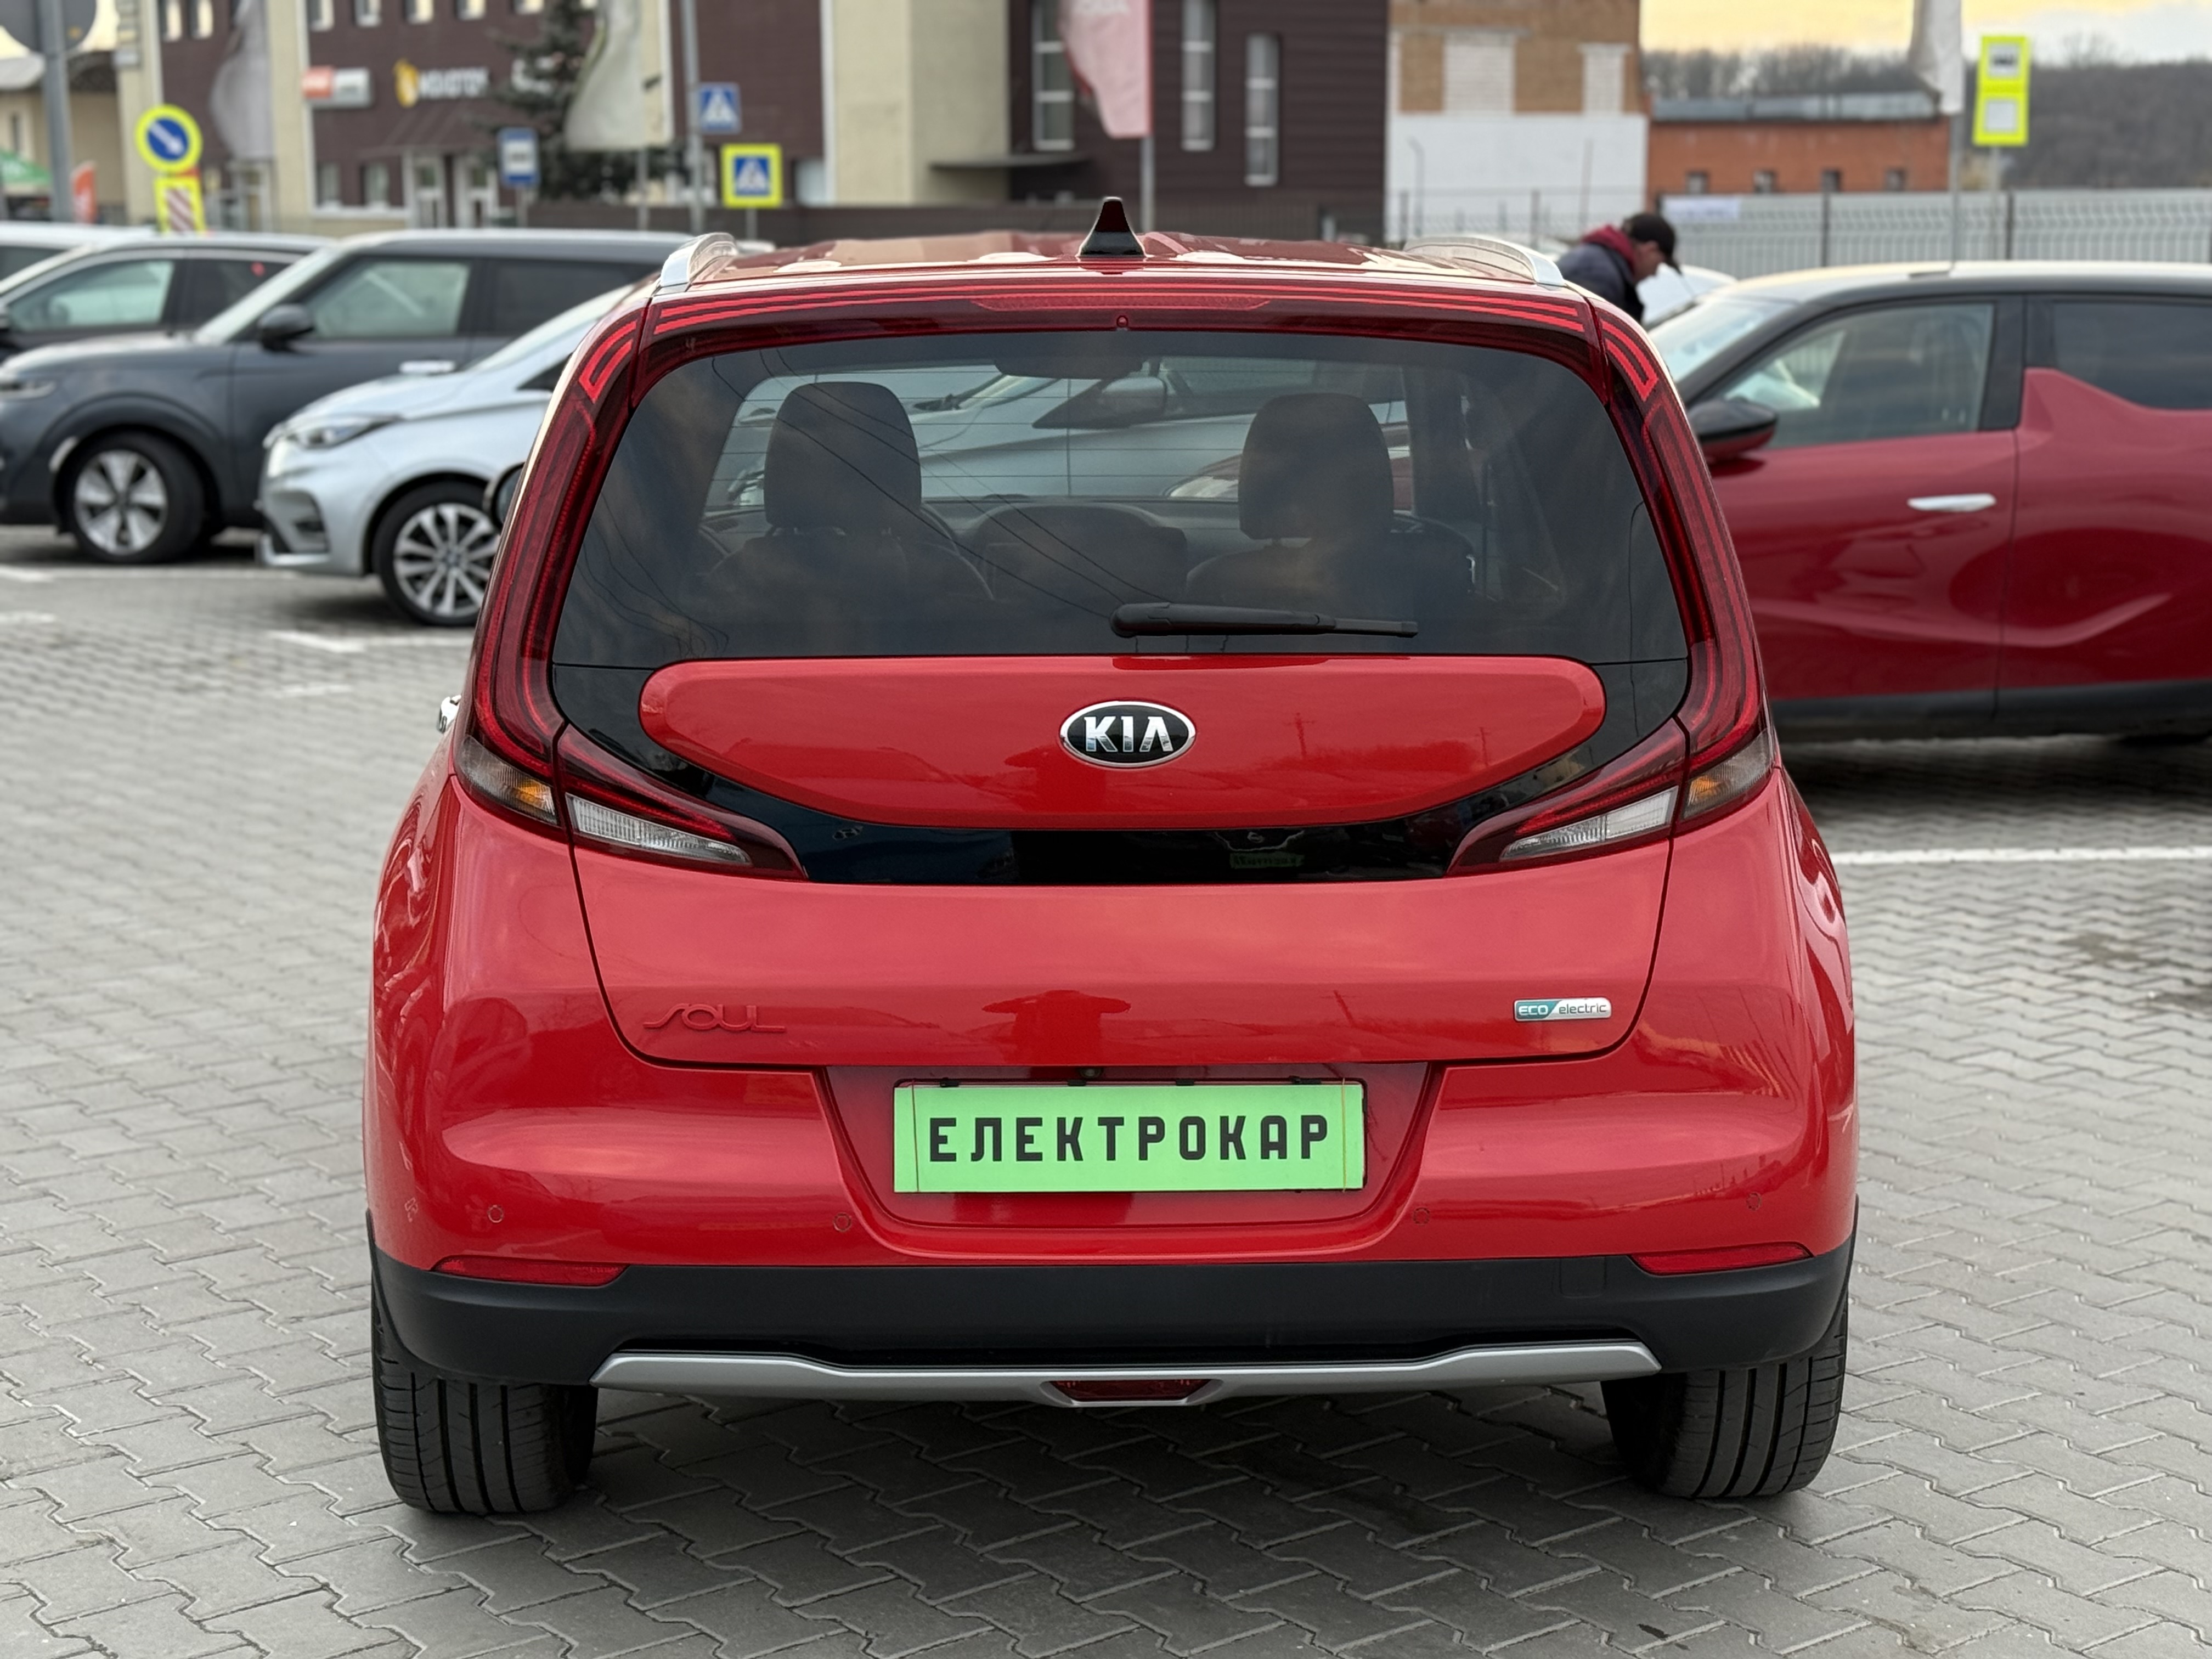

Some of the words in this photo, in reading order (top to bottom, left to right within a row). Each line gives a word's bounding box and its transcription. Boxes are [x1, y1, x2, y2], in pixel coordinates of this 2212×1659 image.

[1084, 716, 1173, 752] KIA
[642, 1003, 786, 1034] SOUL
[1559, 1003, 1607, 1014] electric
[929, 1115, 1328, 1161] ЕЛЕКТРОКАР
